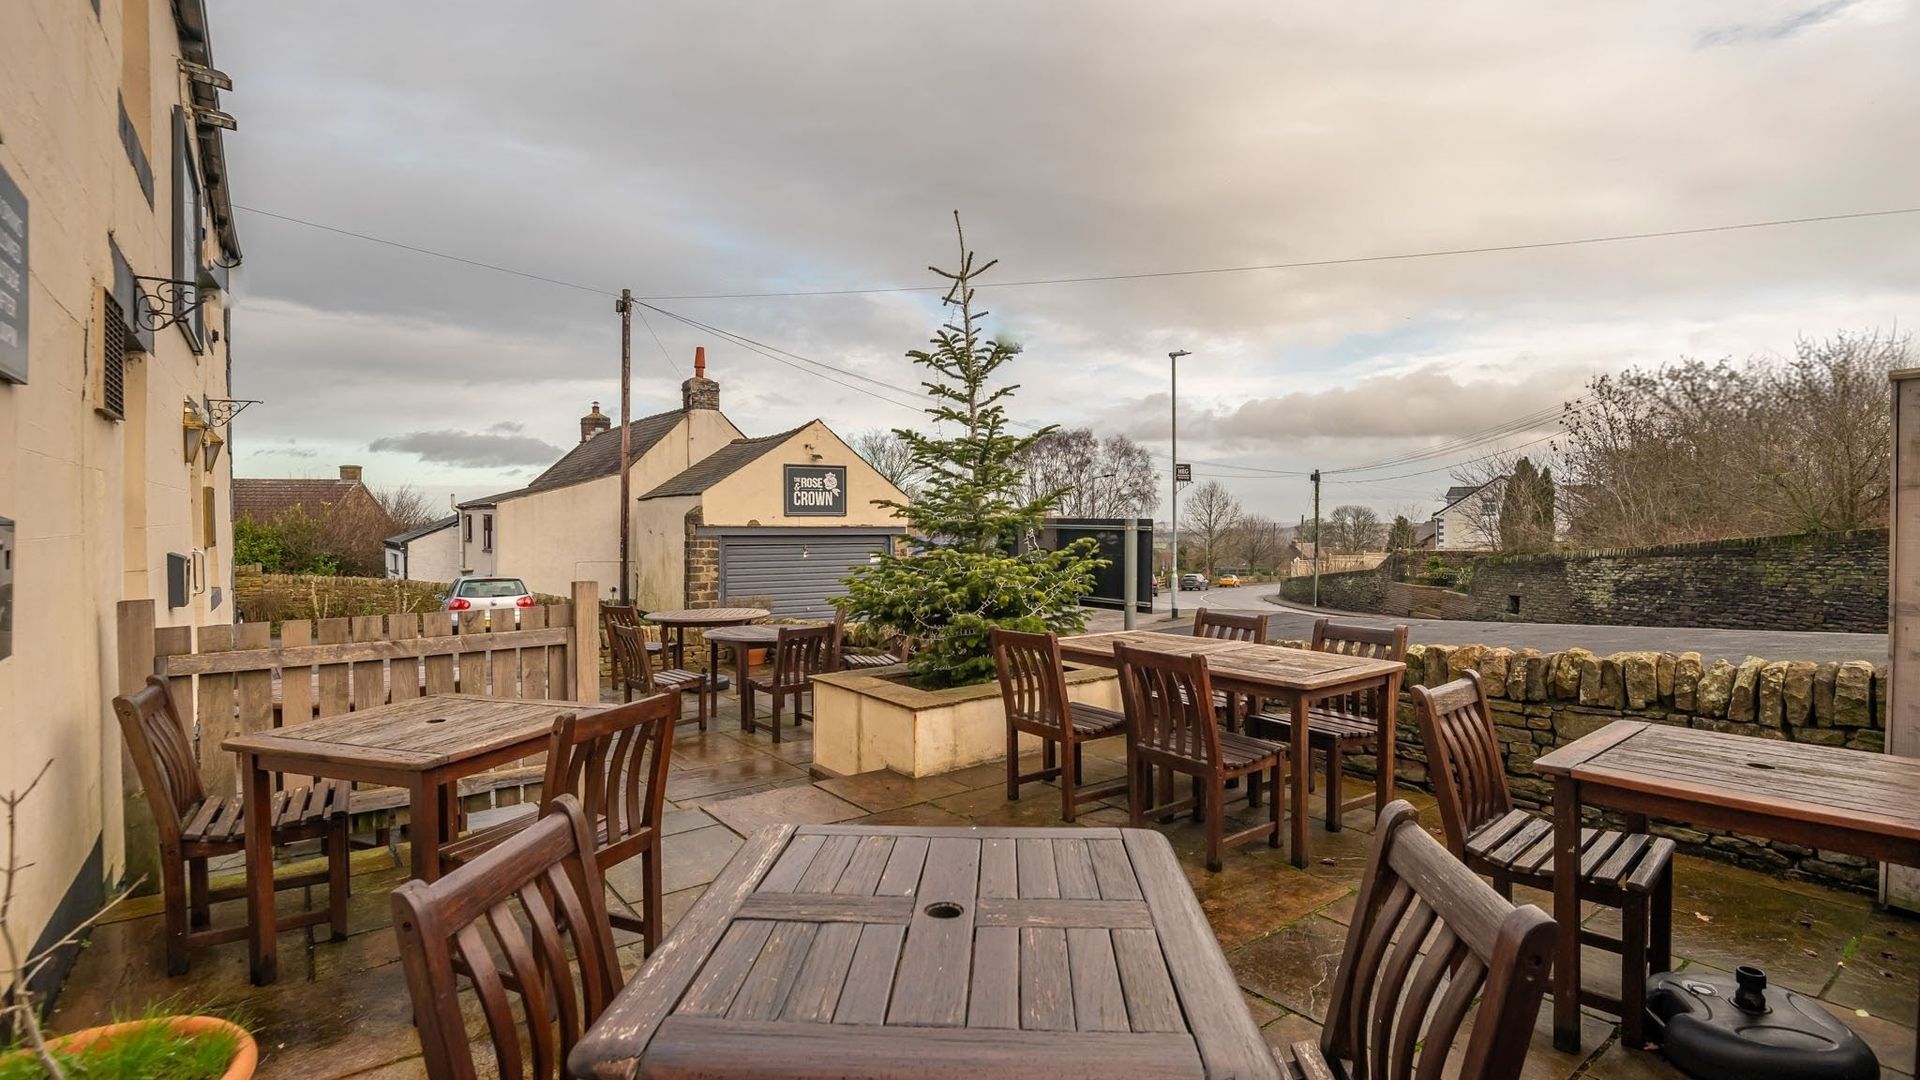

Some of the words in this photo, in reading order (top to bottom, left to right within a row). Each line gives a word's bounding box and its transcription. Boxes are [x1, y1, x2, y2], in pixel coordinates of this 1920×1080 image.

[794, 482, 801, 491] &
[801, 477, 823, 488] ROSE
[793, 491, 833, 506] CROWN
